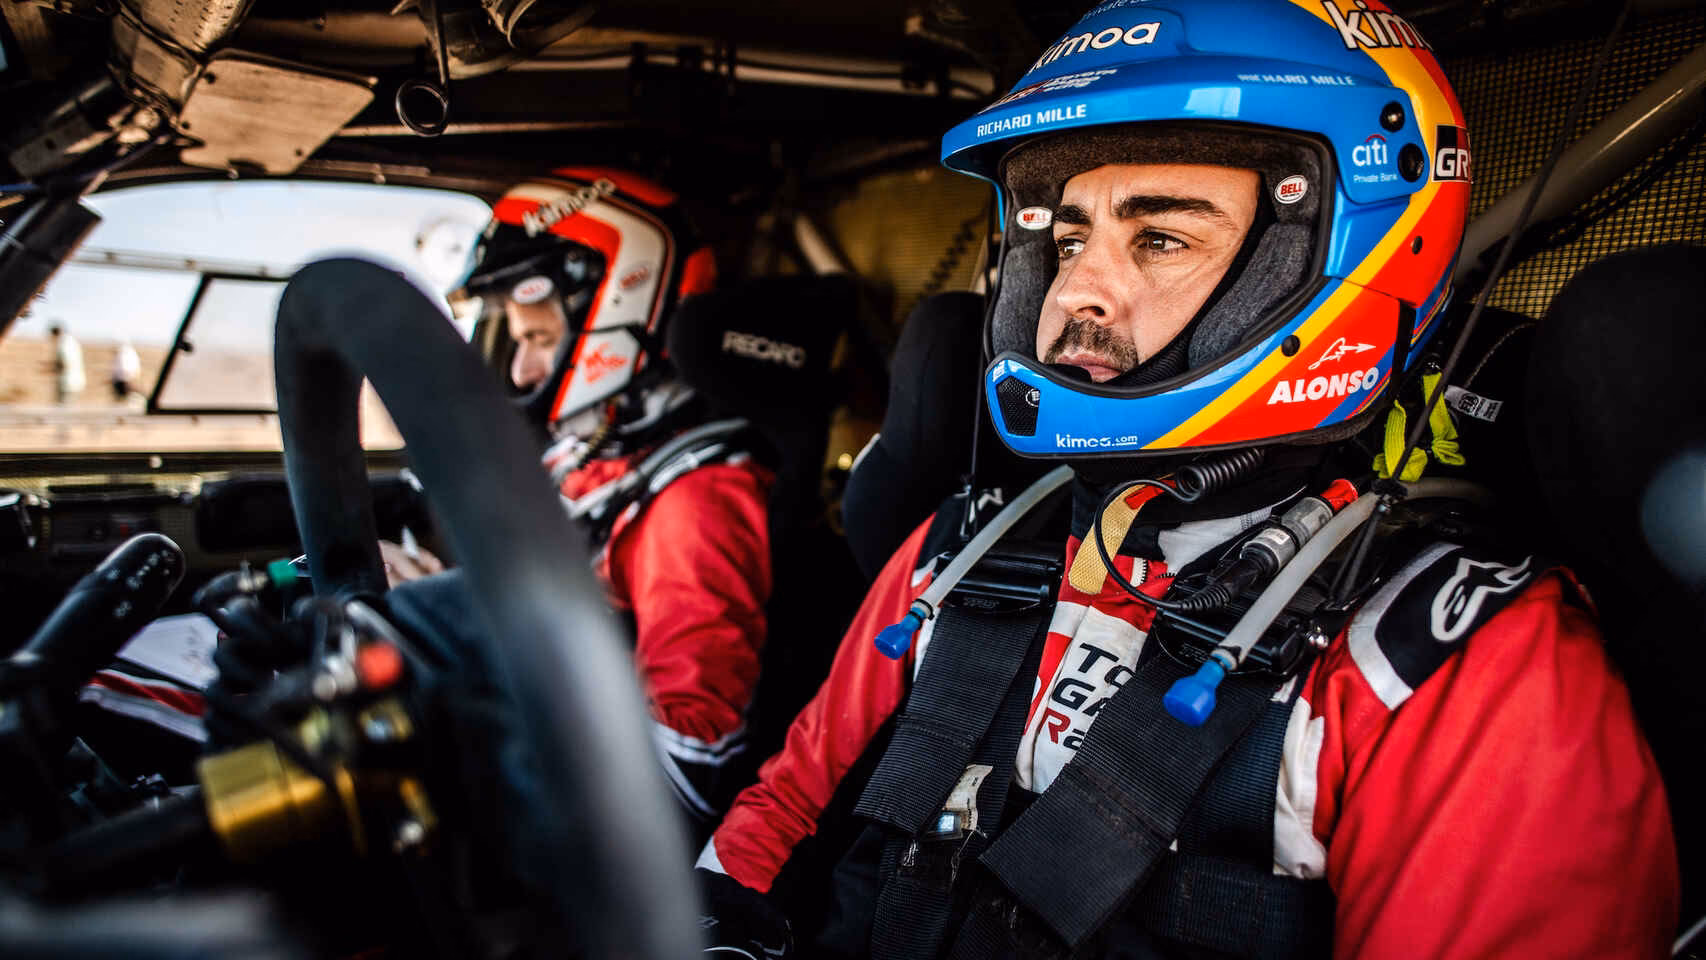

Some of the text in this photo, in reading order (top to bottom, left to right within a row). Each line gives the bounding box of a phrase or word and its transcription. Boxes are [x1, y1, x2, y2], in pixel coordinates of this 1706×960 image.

[1026, 21, 1162, 76] kimoa
[1311, 75, 1355, 87] MILLE
[977, 103, 1088, 137] RICHARD MILLE
[1351, 138, 1389, 167] citi
[1436, 147, 1469, 179] GR
[1353, 173, 1379, 184] Private
[722, 330, 808, 370] RECARO
[1267, 366, 1380, 406] ALONSO
